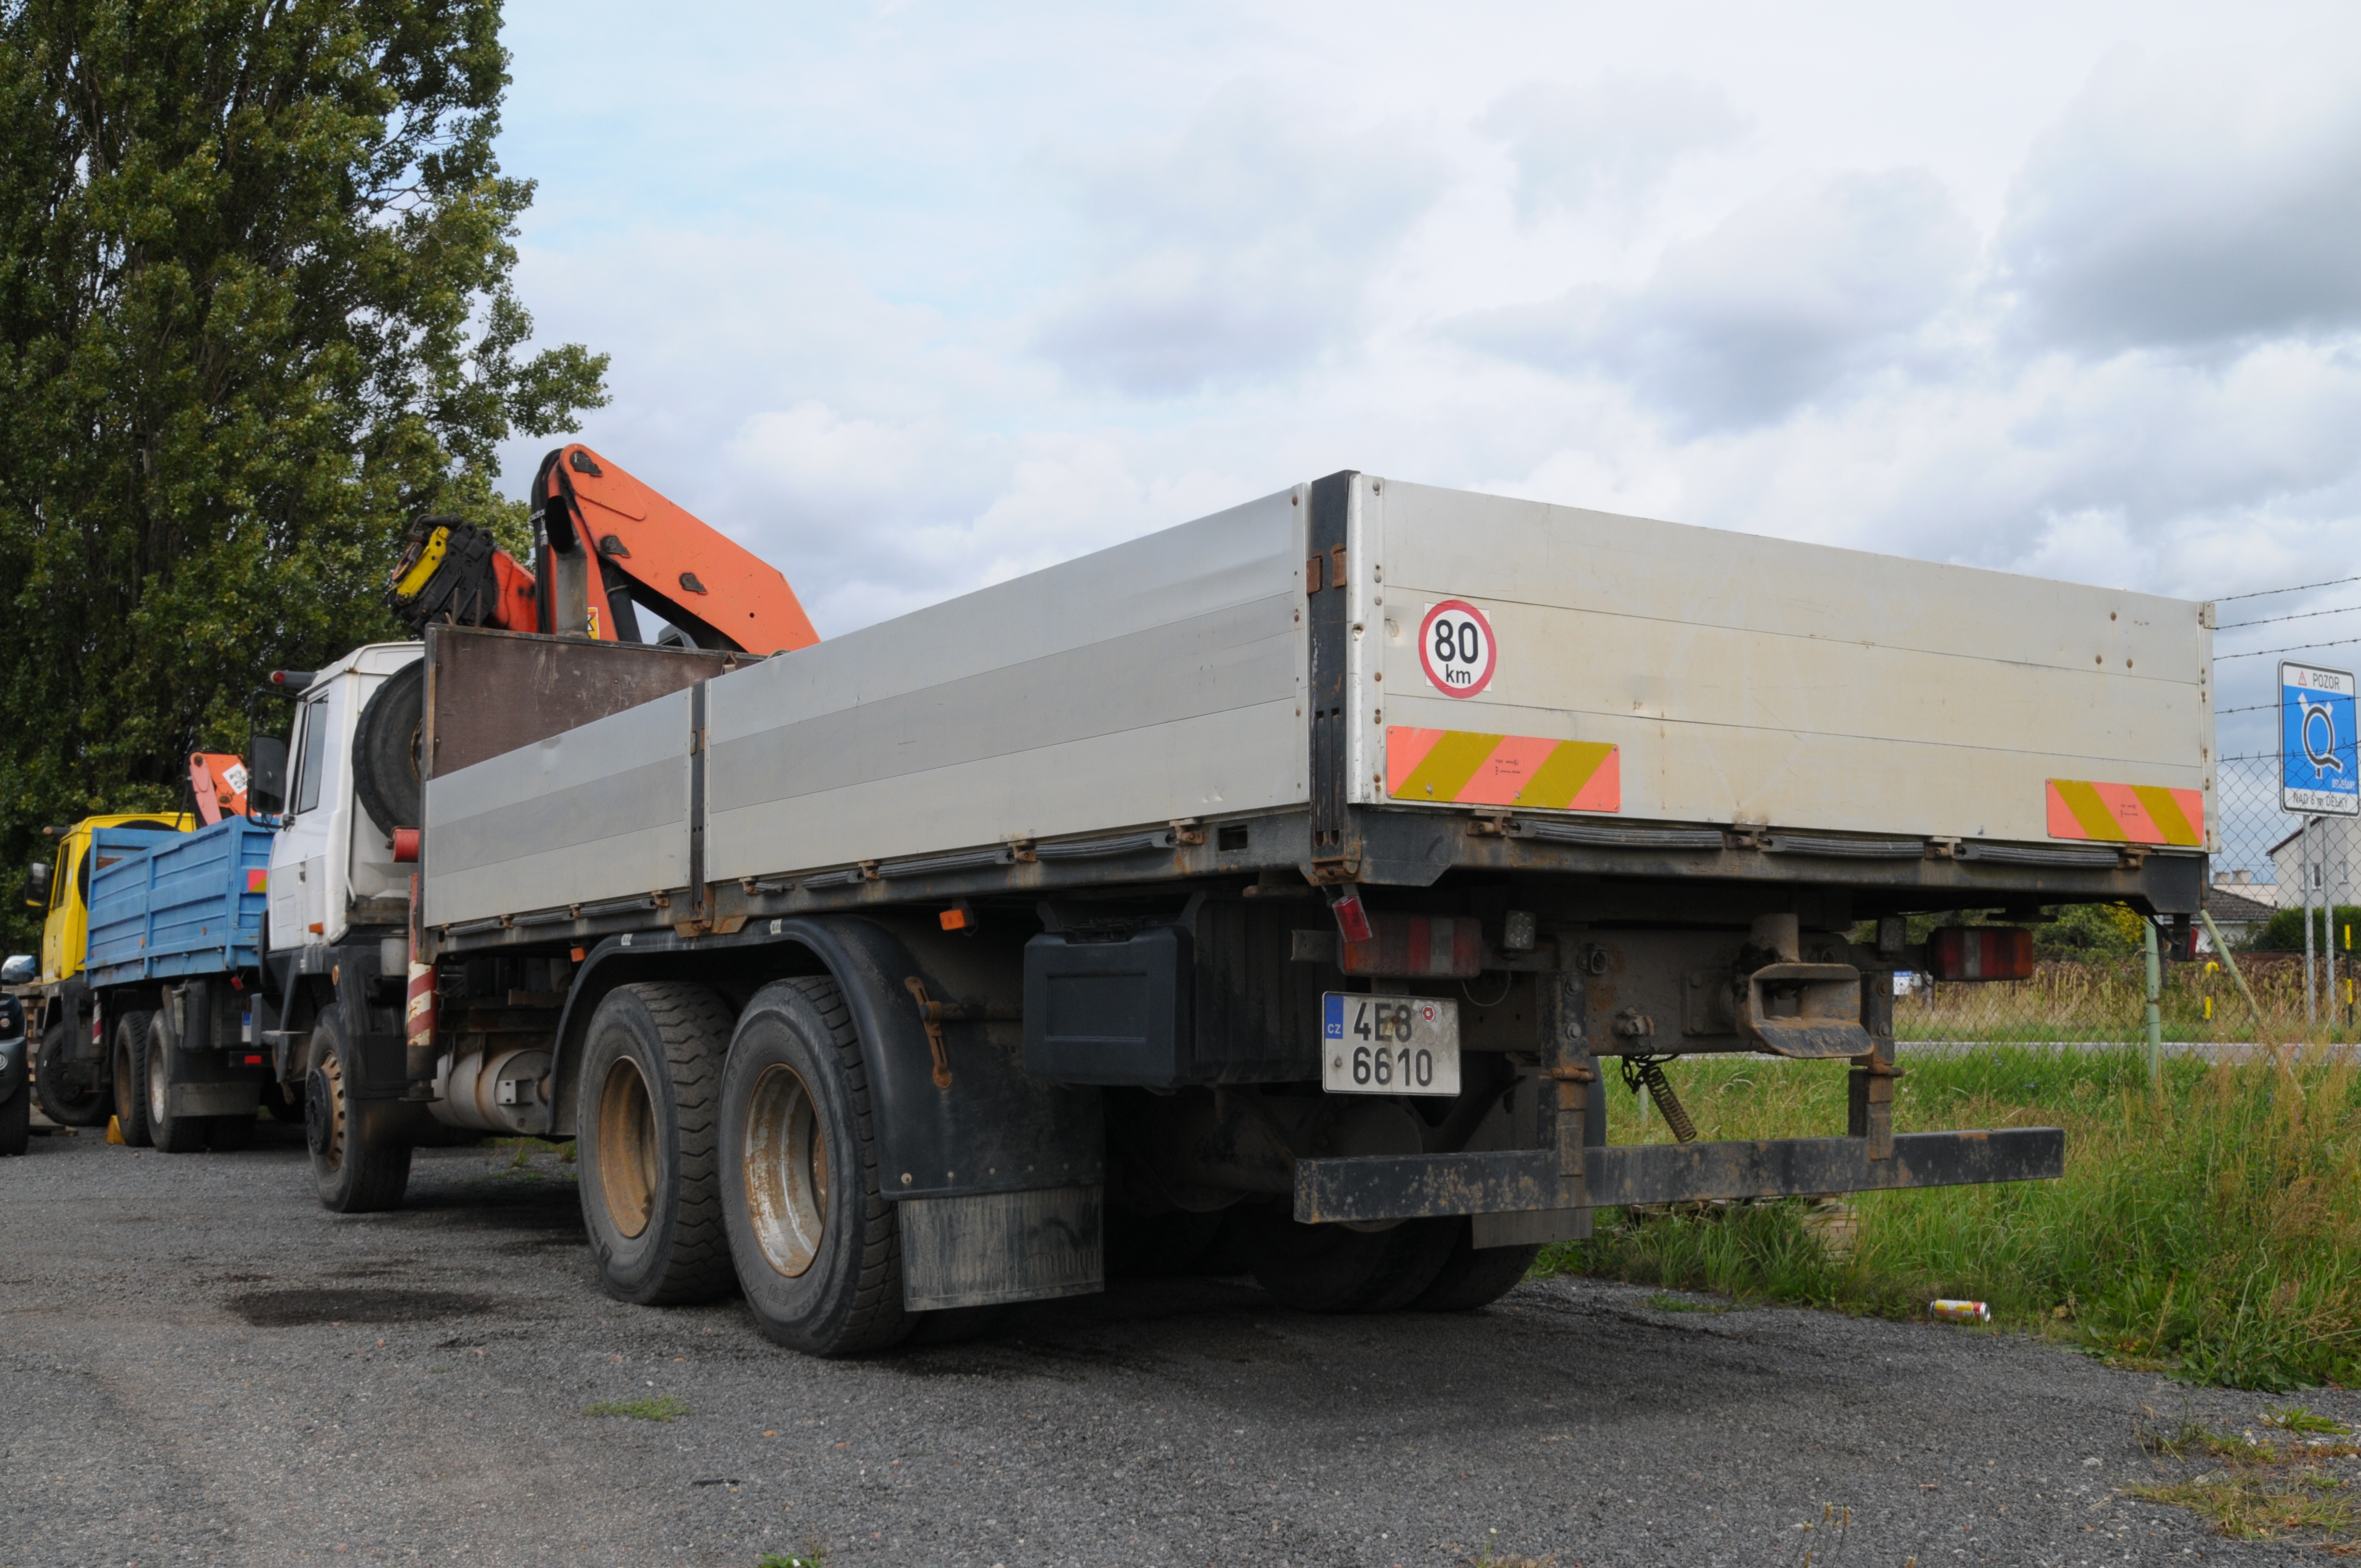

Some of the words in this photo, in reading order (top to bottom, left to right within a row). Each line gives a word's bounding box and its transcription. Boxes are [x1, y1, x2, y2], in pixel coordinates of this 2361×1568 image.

[1435, 619, 1478, 664] 80
[1445, 663, 1471, 684] km
[2313, 673, 2340, 690] POZOR
[2293, 793, 2308, 804] NAD
[2317, 798, 2324, 806] m
[1328, 1023, 1341, 1035] CZ
[1353, 1002, 1412, 1043] 4E8
[1352, 1046, 1433, 1087] 6610
